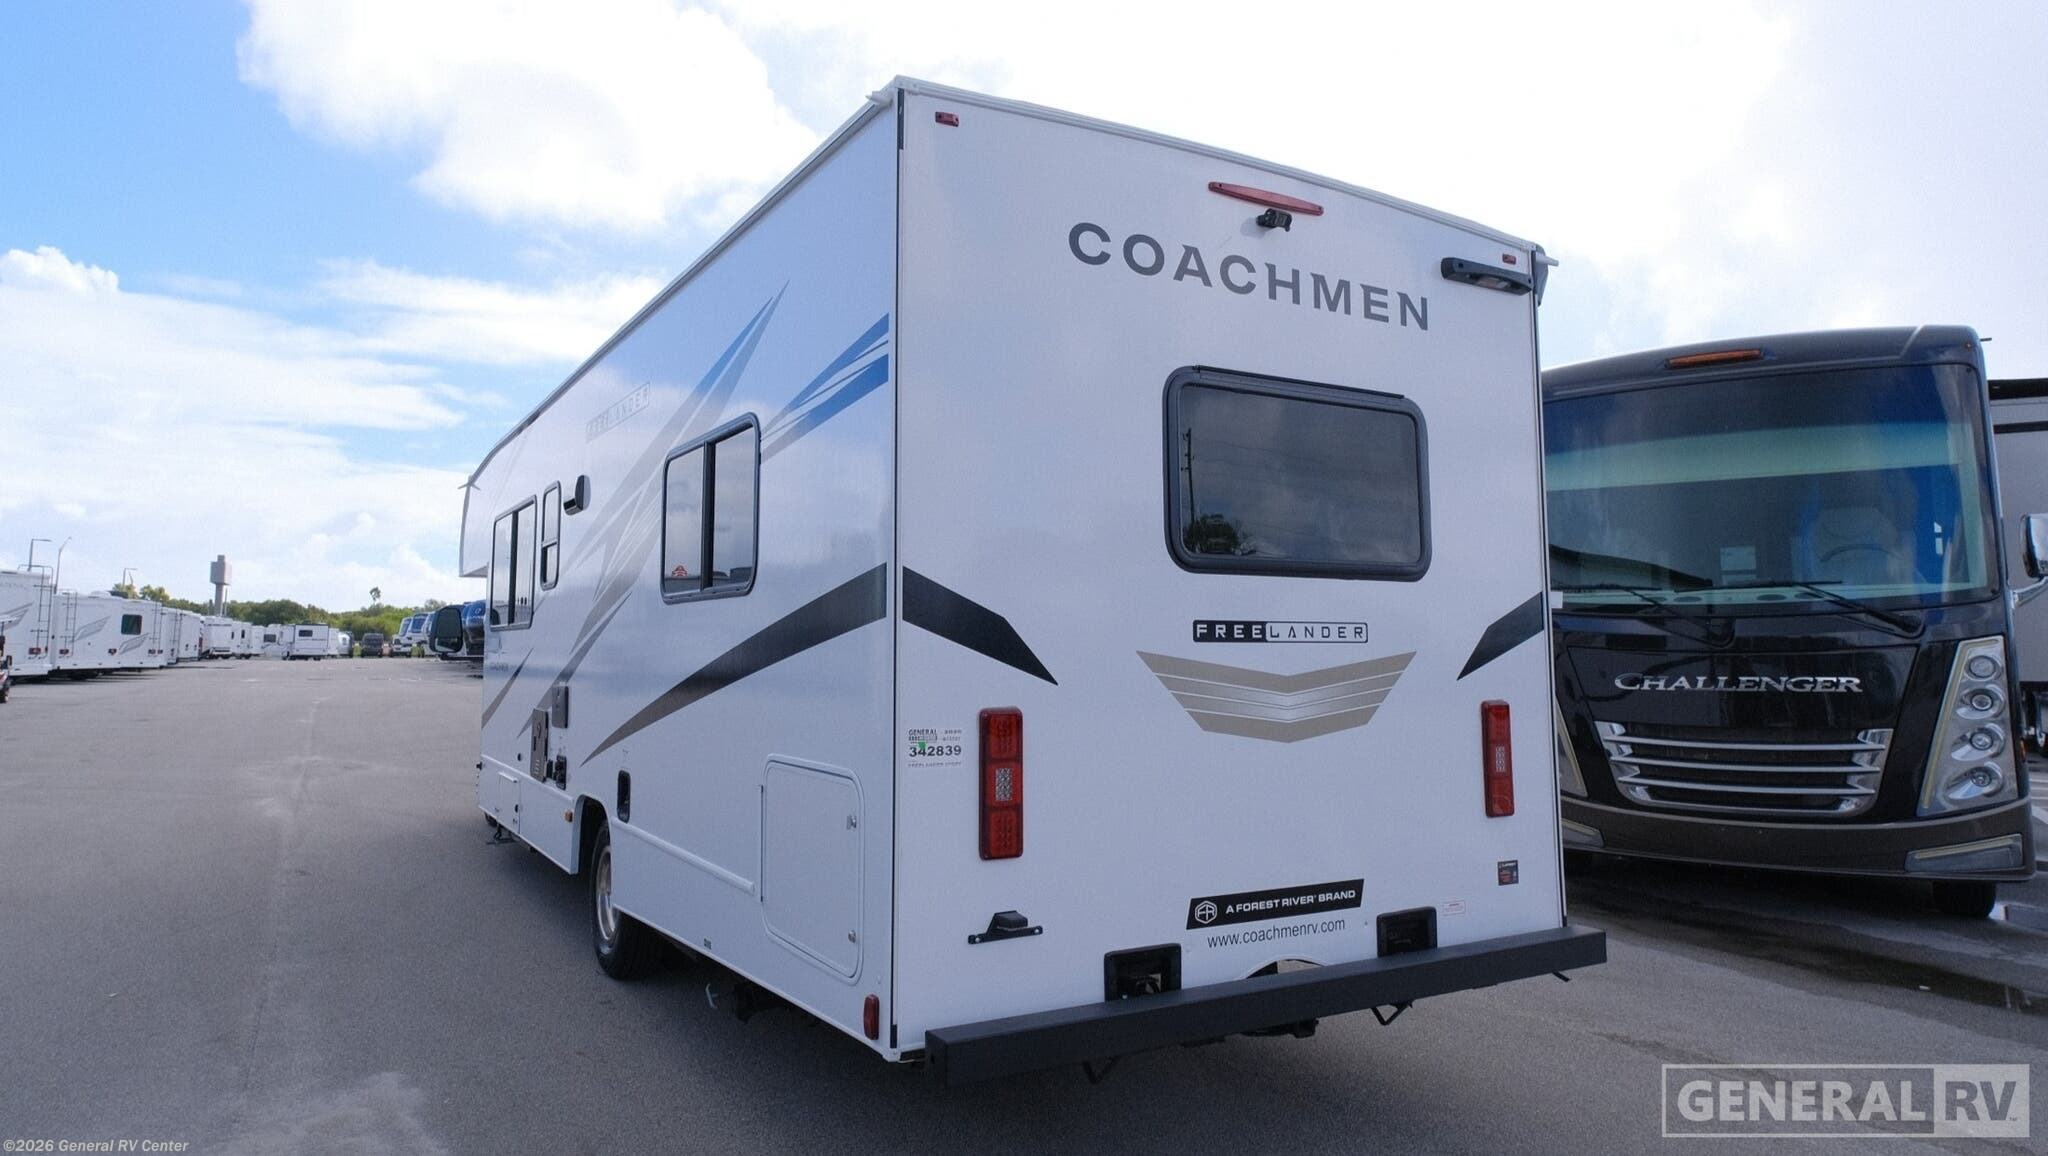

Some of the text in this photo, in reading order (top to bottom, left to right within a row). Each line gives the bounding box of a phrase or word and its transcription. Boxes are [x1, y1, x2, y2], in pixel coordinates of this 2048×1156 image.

[1069, 222, 1428, 331] COACHMEN
[1196, 624, 1363, 639] FREELANDER
[1615, 673, 1863, 693] CHALLENGER
[909, 745, 961, 757] 342839
[1225, 905, 1234, 914] A
[1236, 899, 1280, 913] FOREST
[1318, 889, 1356, 903] BRAND
[1208, 919, 1346, 949] www.coachmenrv.com
